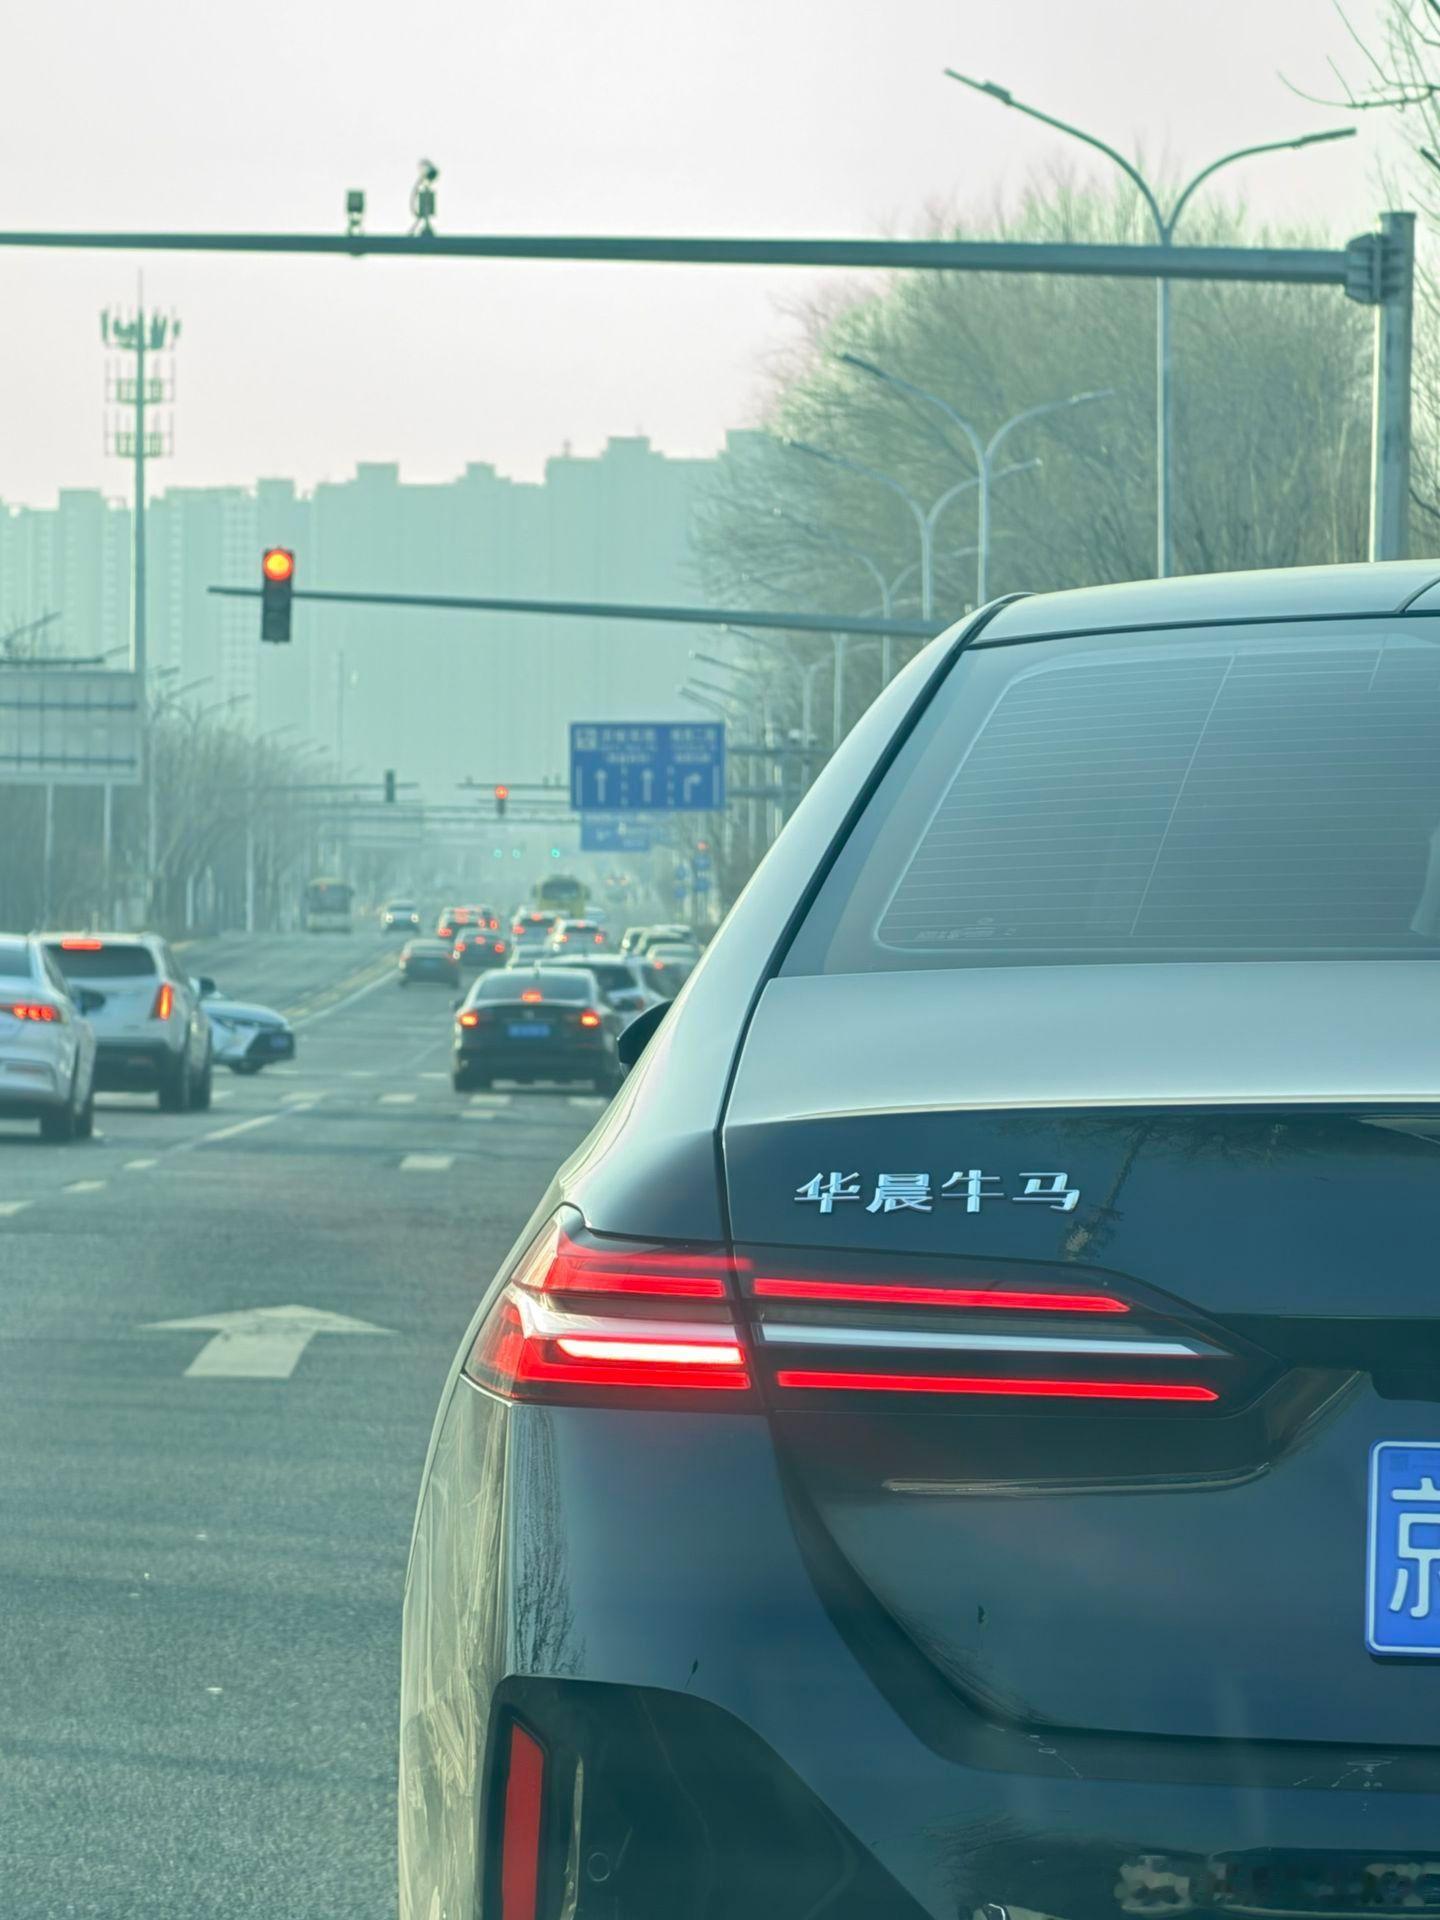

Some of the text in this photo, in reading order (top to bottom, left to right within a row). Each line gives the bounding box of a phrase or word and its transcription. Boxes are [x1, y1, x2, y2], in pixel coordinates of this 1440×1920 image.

[794, 1169, 1081, 1213] 华晨牛马
[1388, 1477, 1440, 1618] 京
